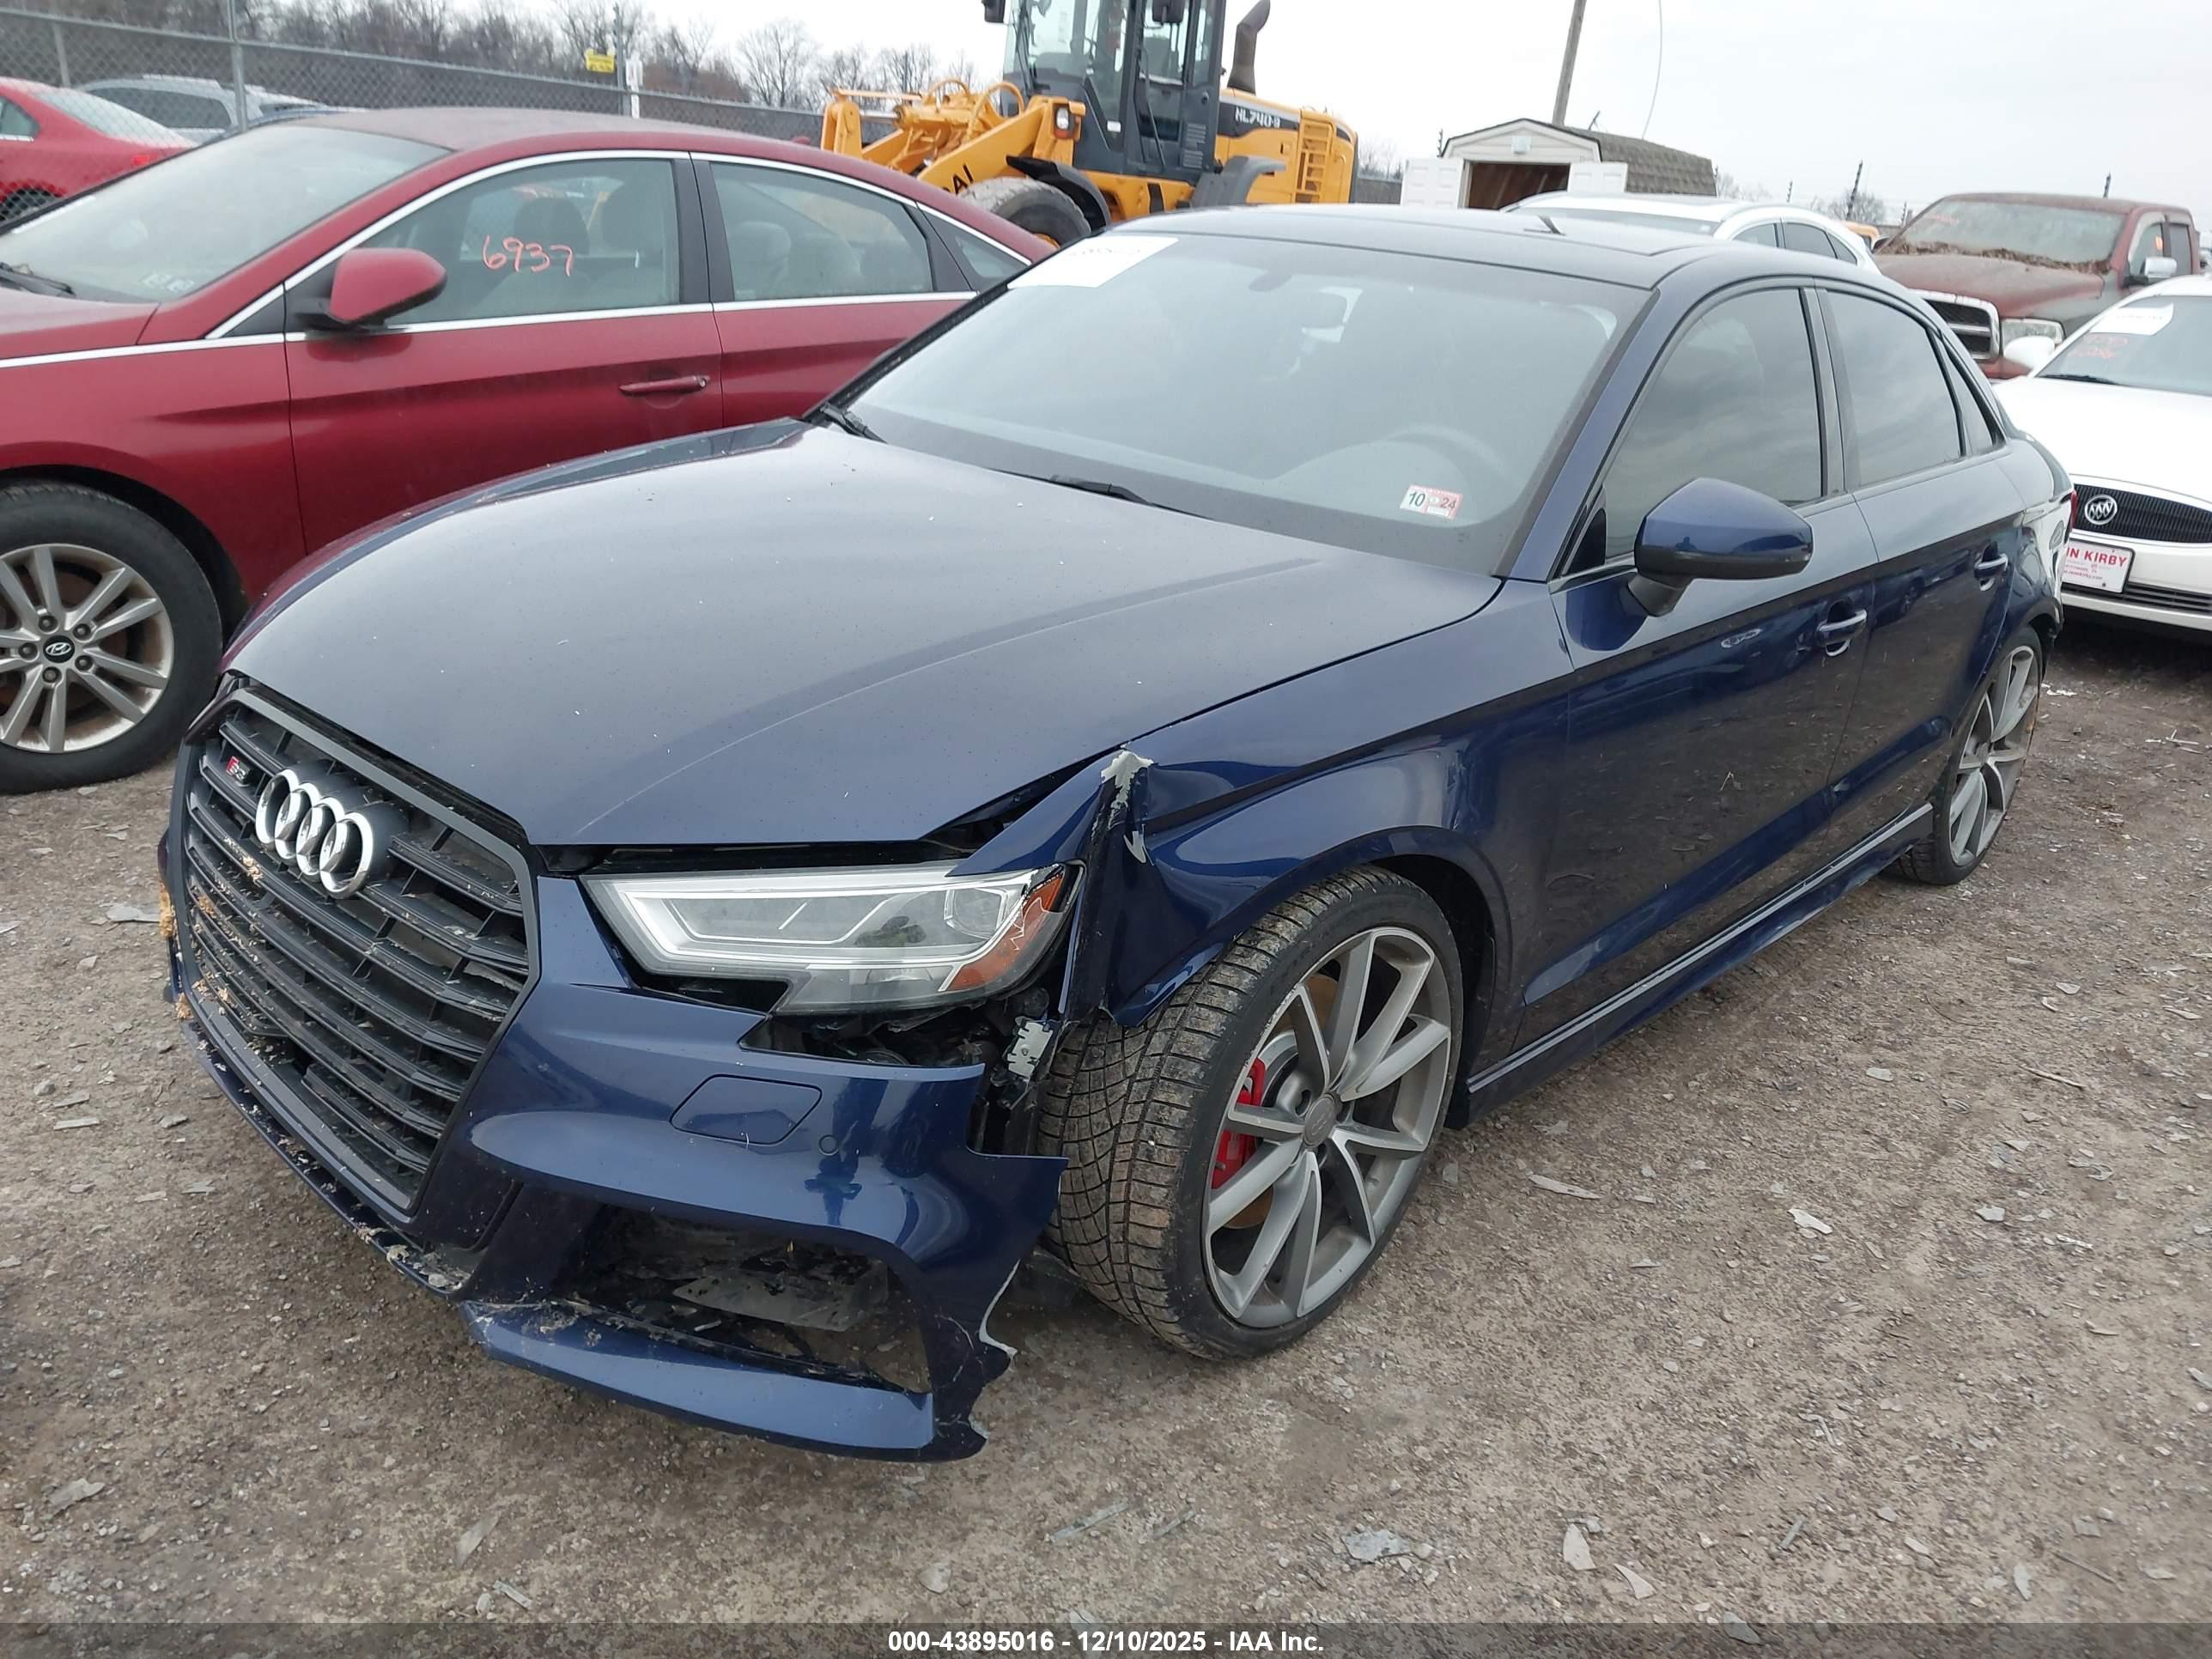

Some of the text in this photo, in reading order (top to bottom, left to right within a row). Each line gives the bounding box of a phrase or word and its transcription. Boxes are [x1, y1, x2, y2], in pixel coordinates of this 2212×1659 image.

[942, 162, 975, 196] AI
[483, 234, 573, 276] 6937
[1409, 491, 1426, 507] 10
[1440, 497, 1456, 510] 24
[2084, 550, 2126, 566] KIRBY
